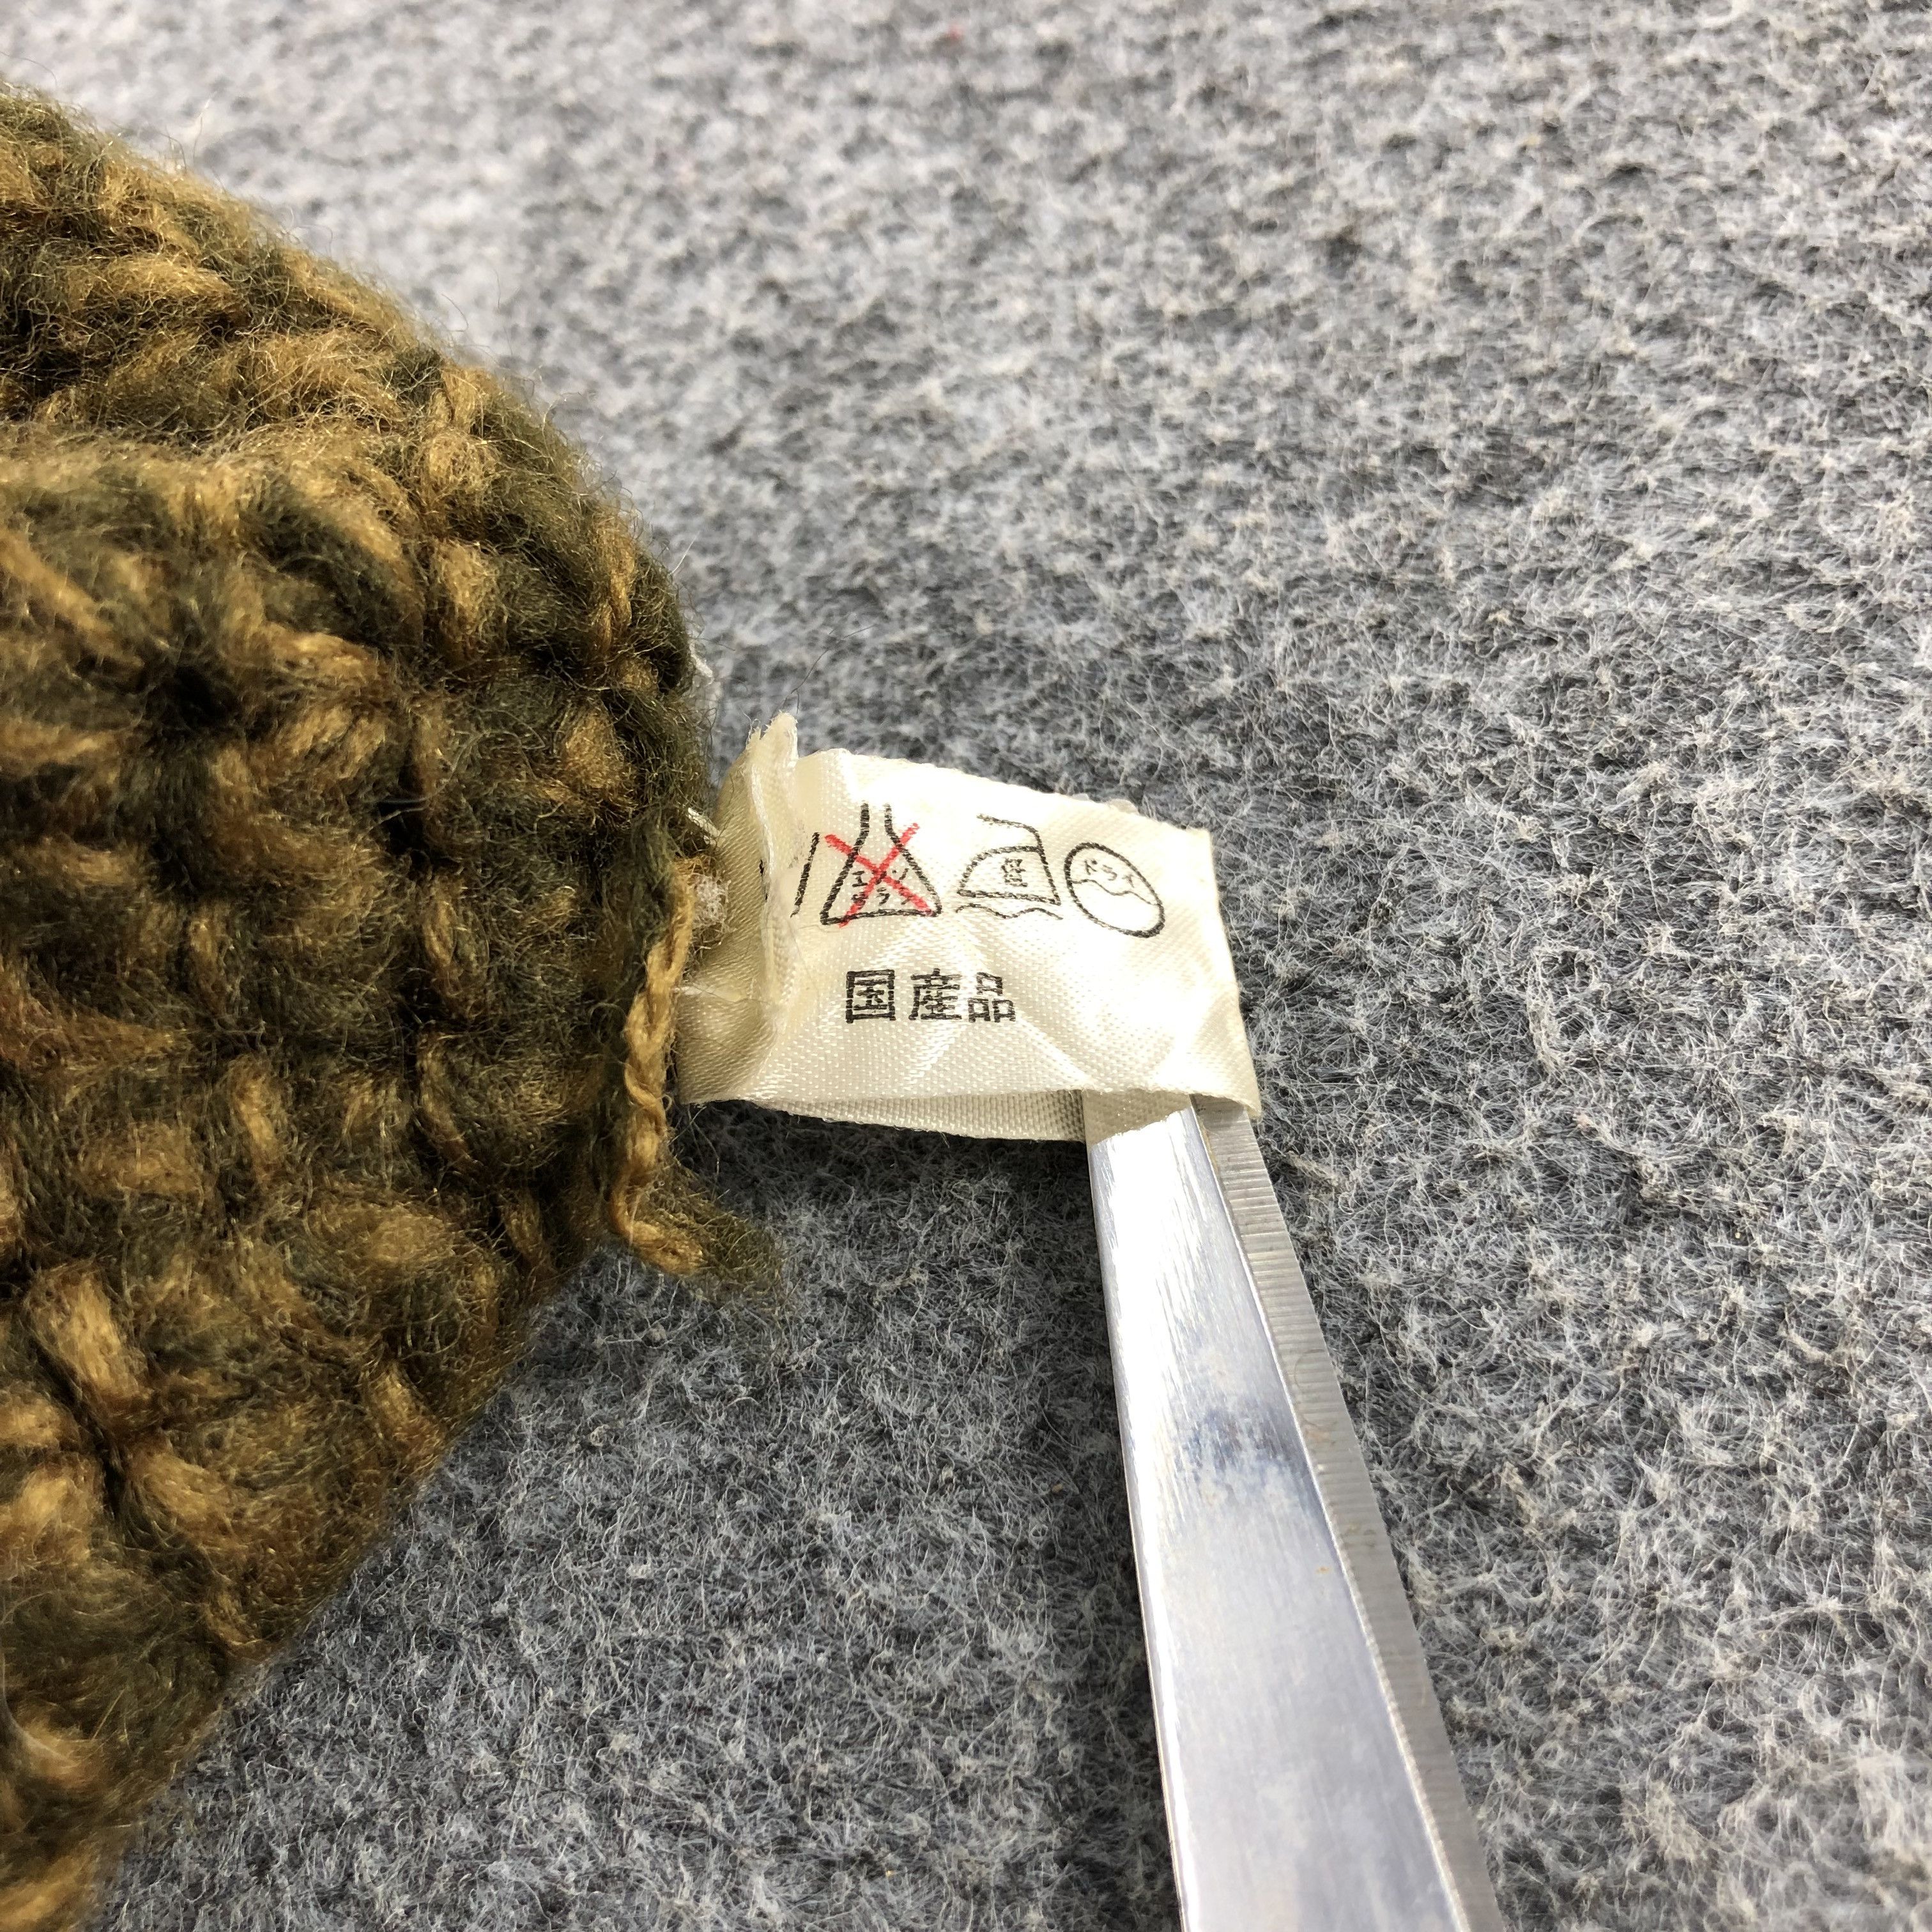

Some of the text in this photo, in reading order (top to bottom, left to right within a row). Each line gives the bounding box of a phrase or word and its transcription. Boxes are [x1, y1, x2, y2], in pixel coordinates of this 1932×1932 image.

[1084, 859, 1135, 888] ドライ
[846, 967, 1016, 1023] 国産品
